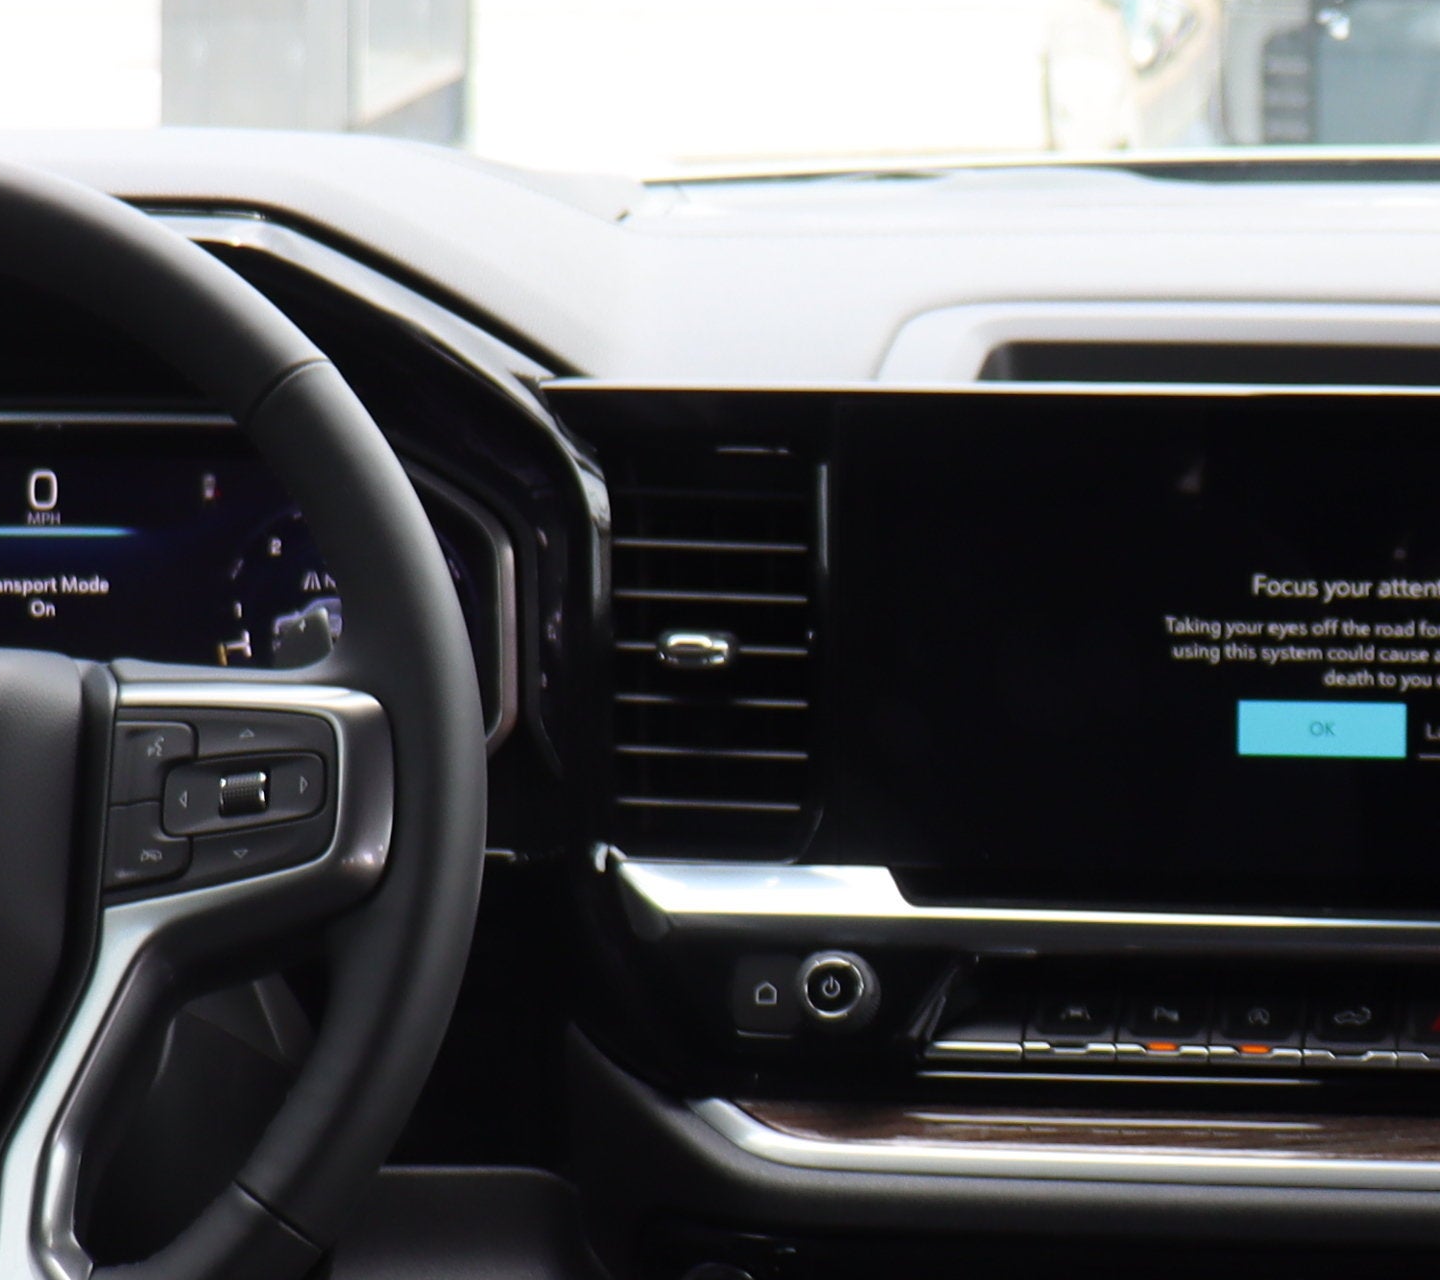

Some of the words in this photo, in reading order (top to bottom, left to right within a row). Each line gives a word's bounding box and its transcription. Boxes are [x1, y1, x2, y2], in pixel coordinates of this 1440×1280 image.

[29, 469, 58, 510] 0
[28, 512, 61, 525] MPH
[270, 536, 282, 555] 2
[60, 574, 110, 593] Mode
[1252, 574, 1318, 598] Focus
[1322, 581, 1373, 603] your
[30, 600, 56, 617] On
[1166, 618, 1220, 639] Taking
[1225, 624, 1264, 639] your
[1268, 623, 1308, 640] eyes
[1312, 619, 1339, 636] off
[1342, 620, 1371, 636] the
[1375, 621, 1414, 638] road
[1172, 644, 1220, 664] using
[1225, 644, 1257, 660] this
[1262, 646, 1322, 665] system
[1327, 644, 1375, 661] could
[1379, 648, 1429, 662] cause
[1324, 668, 1374, 686] death
[1378, 672, 1396, 686] to
[1400, 674, 1432, 692] you
[1310, 722, 1336, 736] OK
